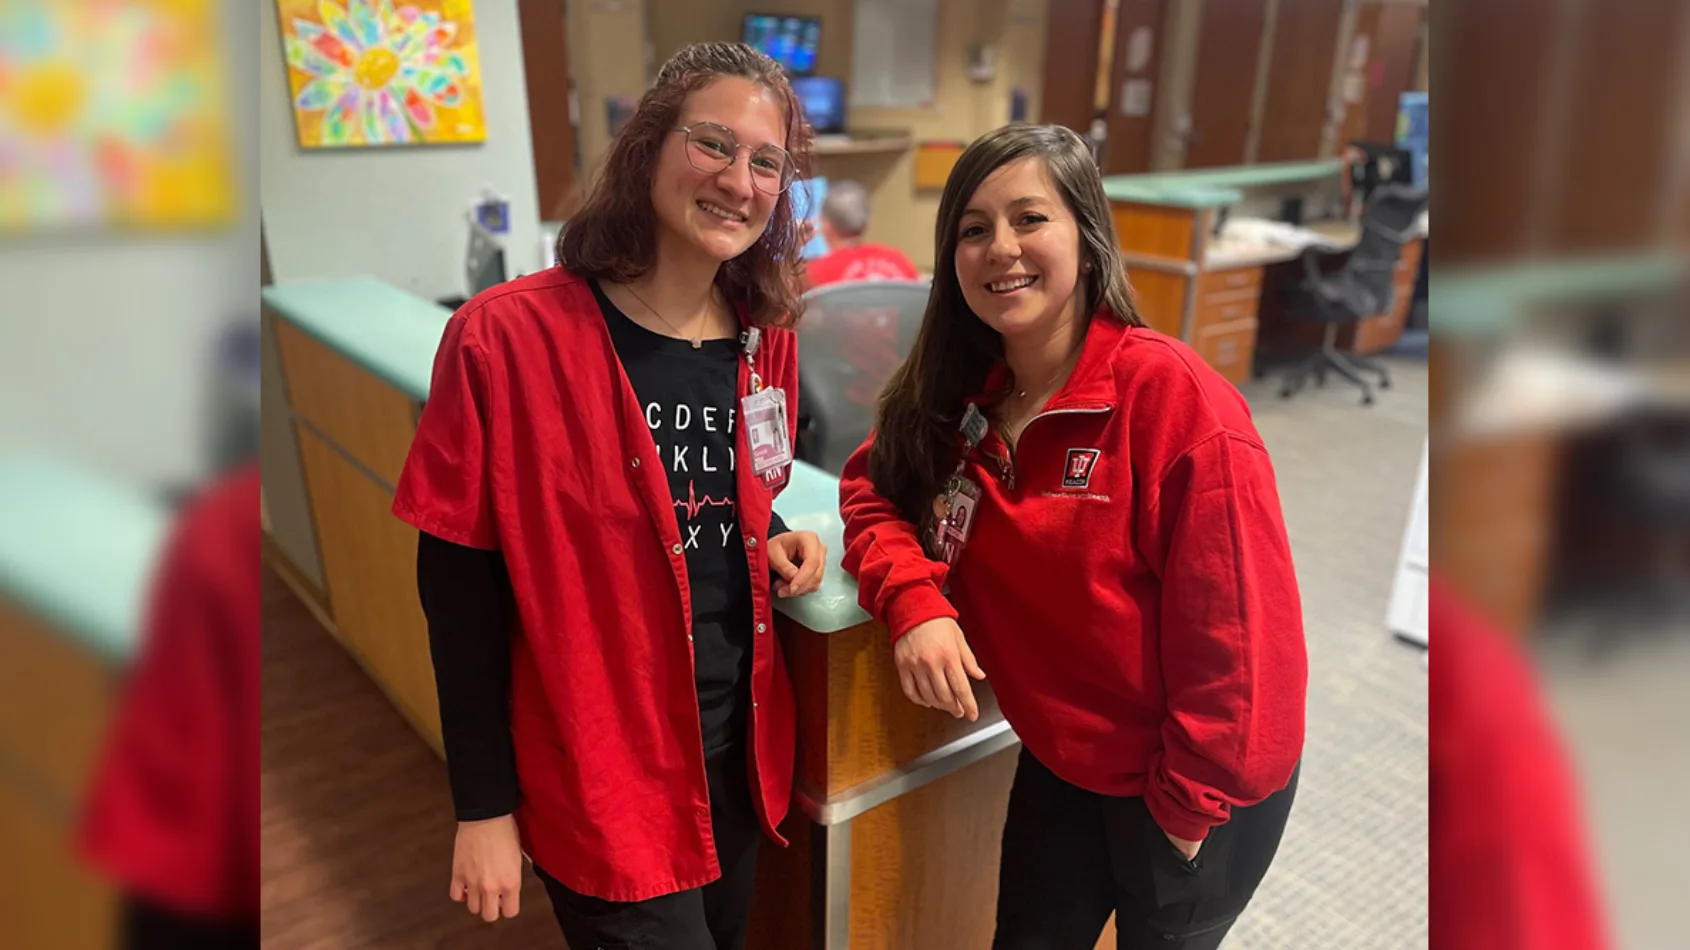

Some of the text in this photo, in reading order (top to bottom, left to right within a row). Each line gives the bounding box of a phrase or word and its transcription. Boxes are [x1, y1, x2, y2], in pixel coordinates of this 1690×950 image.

[646, 402, 661, 429] C
[675, 404, 691, 430] D
[703, 407, 717, 431] E
[673, 445, 688, 472] K
[703, 446, 717, 471] L
[684, 522, 733, 549] X Y
